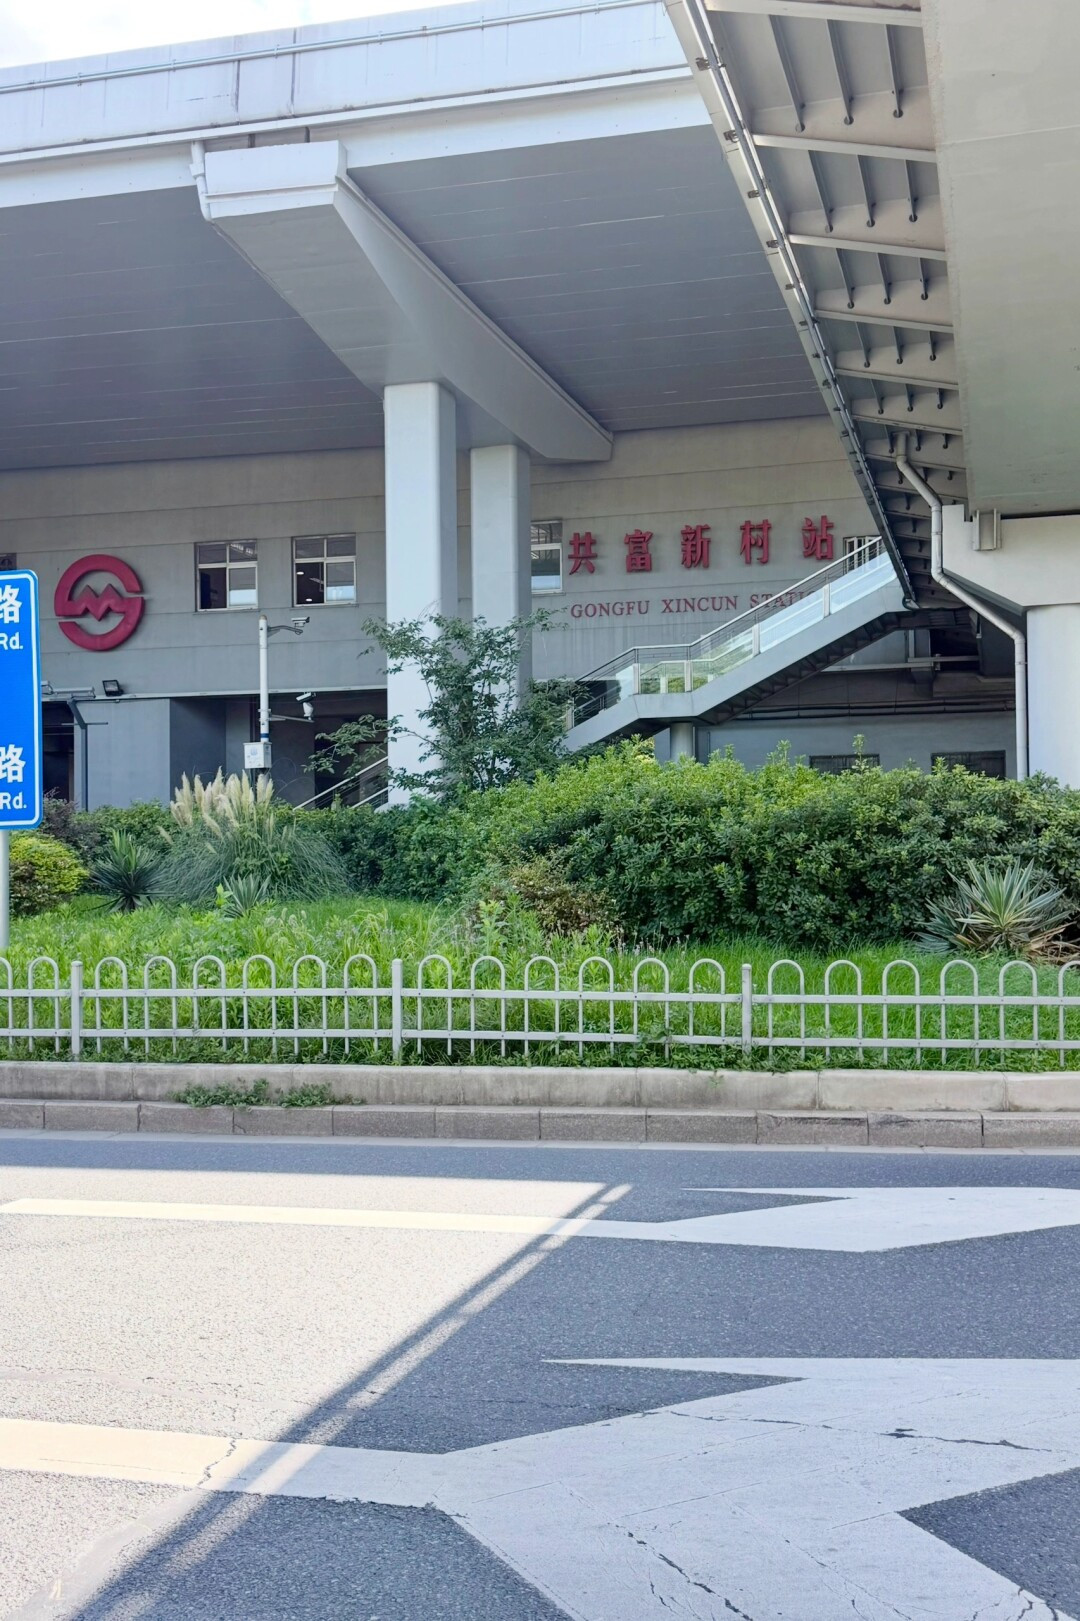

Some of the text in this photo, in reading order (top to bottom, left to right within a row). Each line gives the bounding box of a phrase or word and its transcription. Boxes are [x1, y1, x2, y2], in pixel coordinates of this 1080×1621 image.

[568, 515, 834, 575] 共富新村站
[570, 600, 650, 618] GONGFU
[661, 595, 739, 614] XINCUN
[0, 744, 26, 783] 路
[0, 792, 27, 810] Rd.
